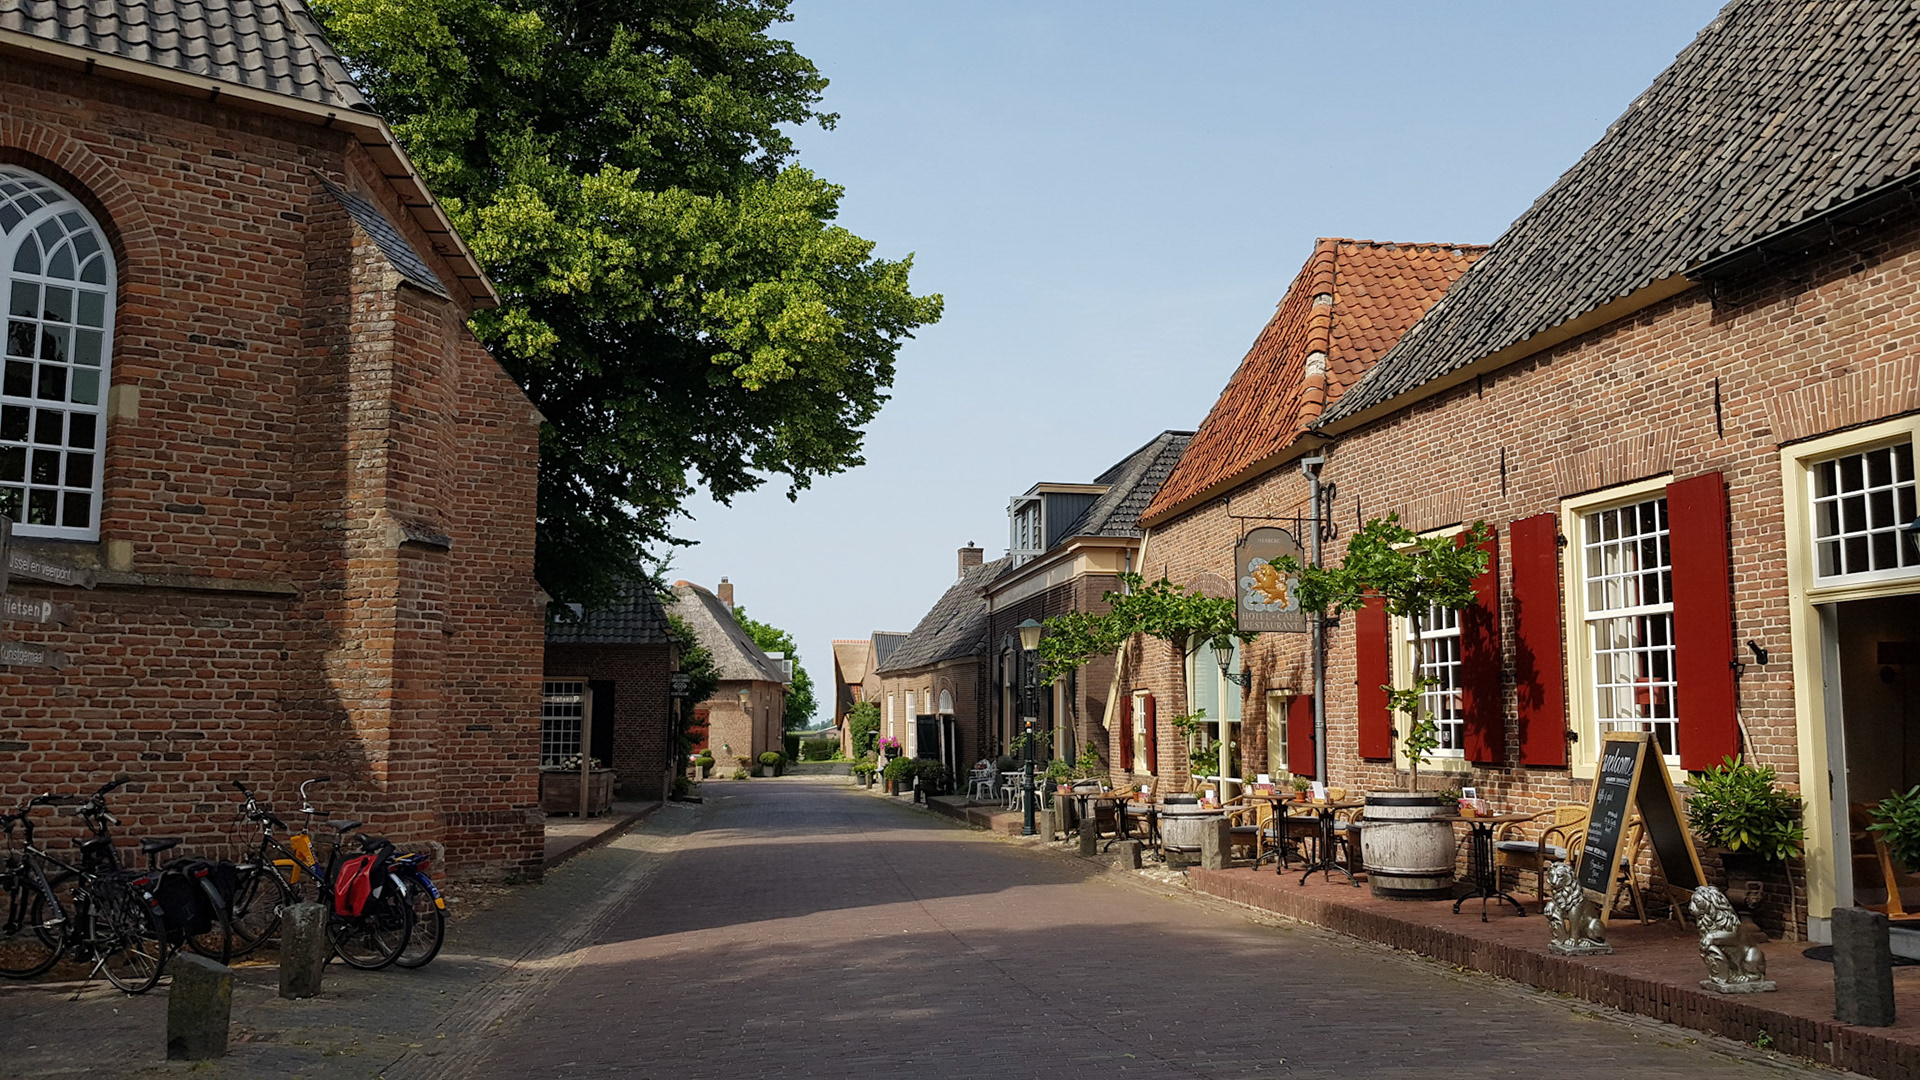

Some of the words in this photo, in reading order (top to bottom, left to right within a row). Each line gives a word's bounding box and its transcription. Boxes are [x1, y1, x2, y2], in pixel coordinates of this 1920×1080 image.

[30, 561, 40, 573] en
[41, 564, 71, 581] veerpont
[40, 601, 52, 623] P
[1242, 612, 1271, 621] HOTEL
[1244, 621, 1300, 630] RESTAURANT
